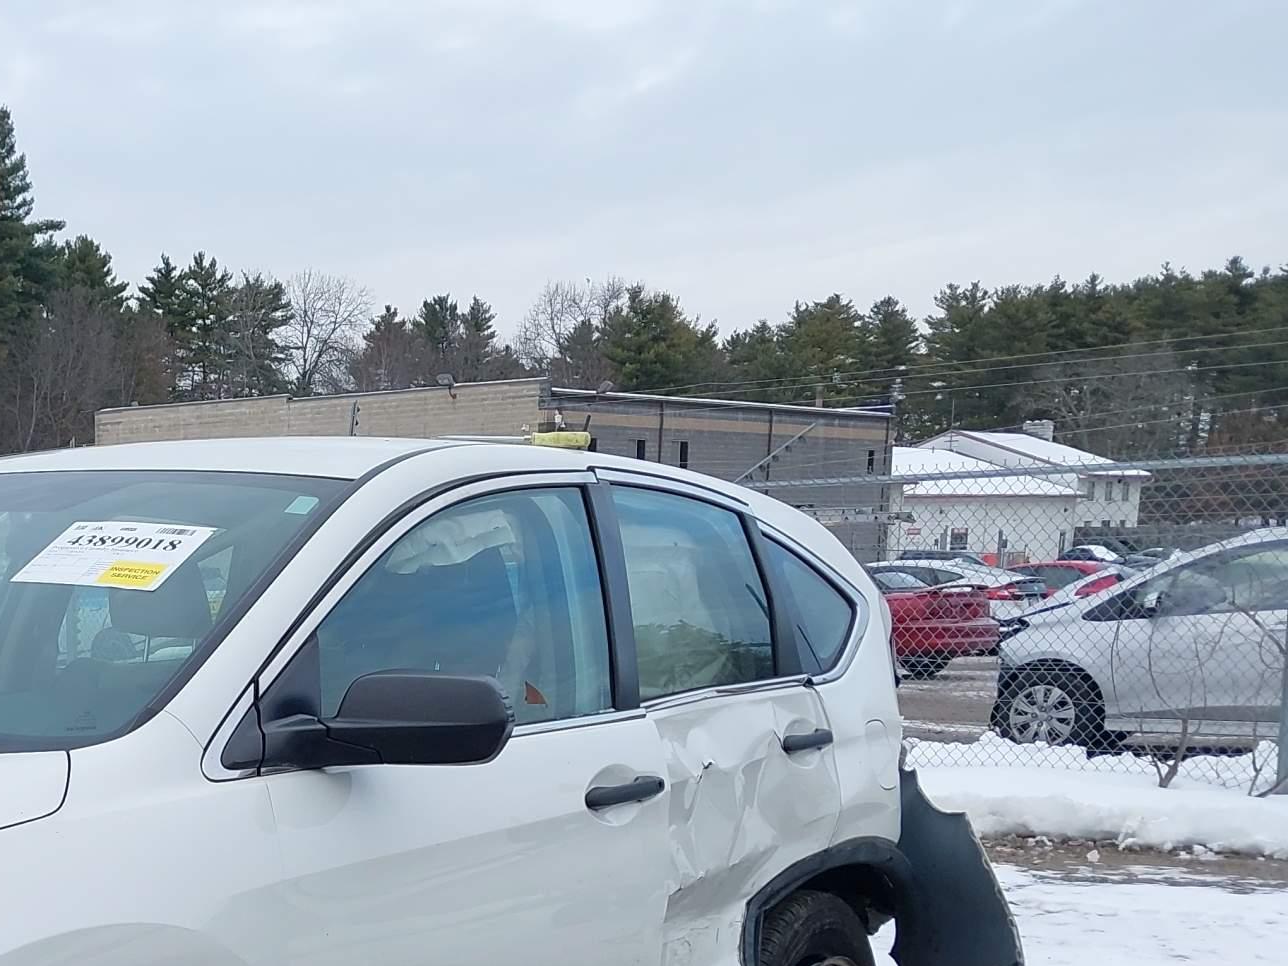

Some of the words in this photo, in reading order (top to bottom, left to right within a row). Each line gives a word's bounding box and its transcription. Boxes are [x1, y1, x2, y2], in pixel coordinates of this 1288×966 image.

[67, 534, 183, 552] 43899018
[110, 565, 161, 576] INSPECTION
[111, 572, 149, 581] SERVICE
